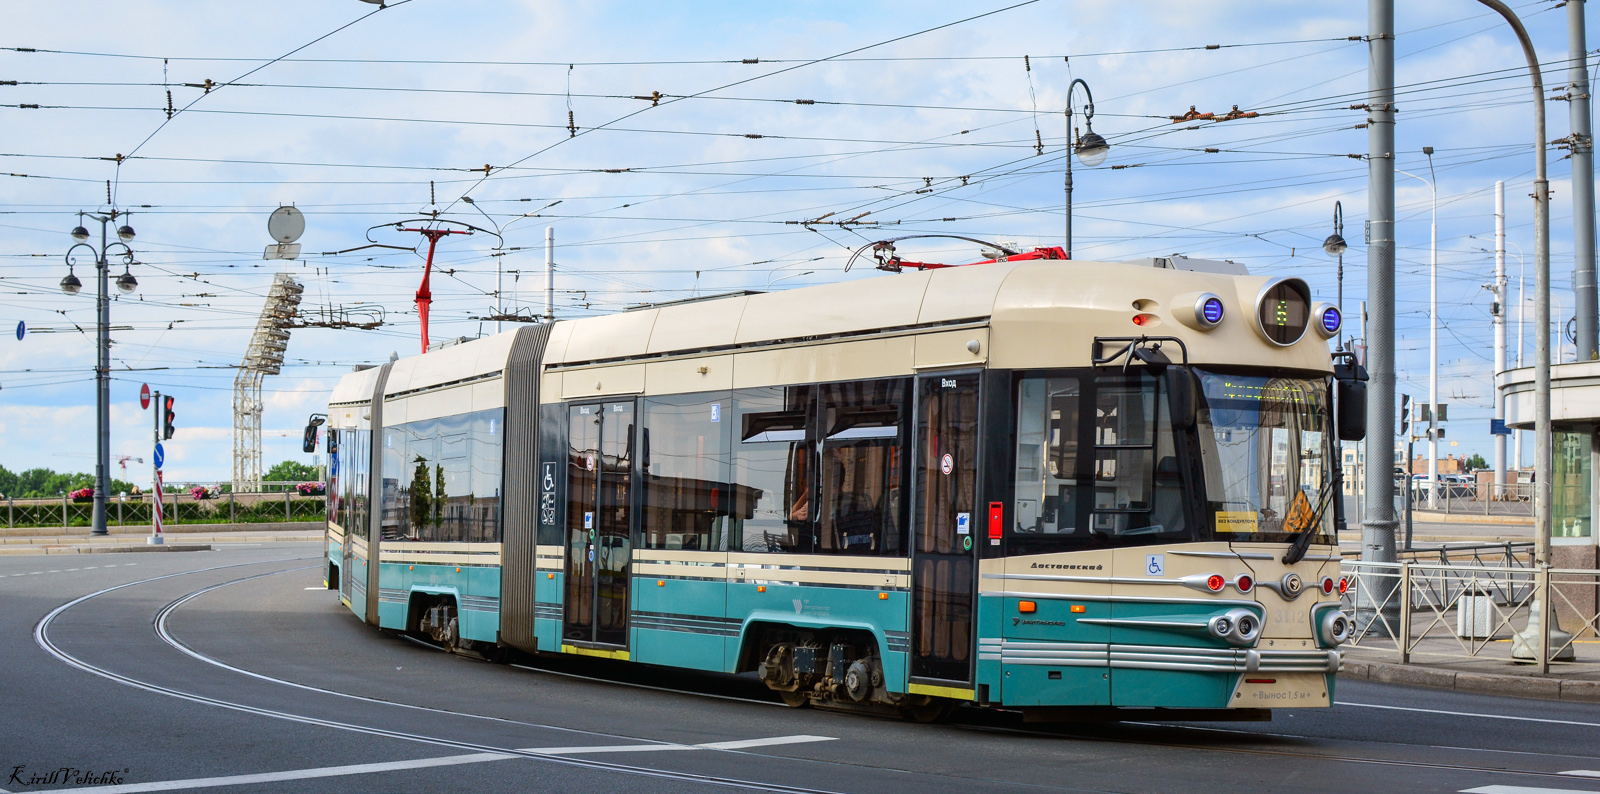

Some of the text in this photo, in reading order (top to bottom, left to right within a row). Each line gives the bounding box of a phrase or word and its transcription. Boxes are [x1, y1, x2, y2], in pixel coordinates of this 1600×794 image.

[941, 378, 957, 389] Вход
[1030, 562, 1103, 570] Достоевский
[1274, 609, 1305, 624] 3112
[1258, 690, 1287, 700] Вынос
[1288, 690, 1299, 700] 1,5
